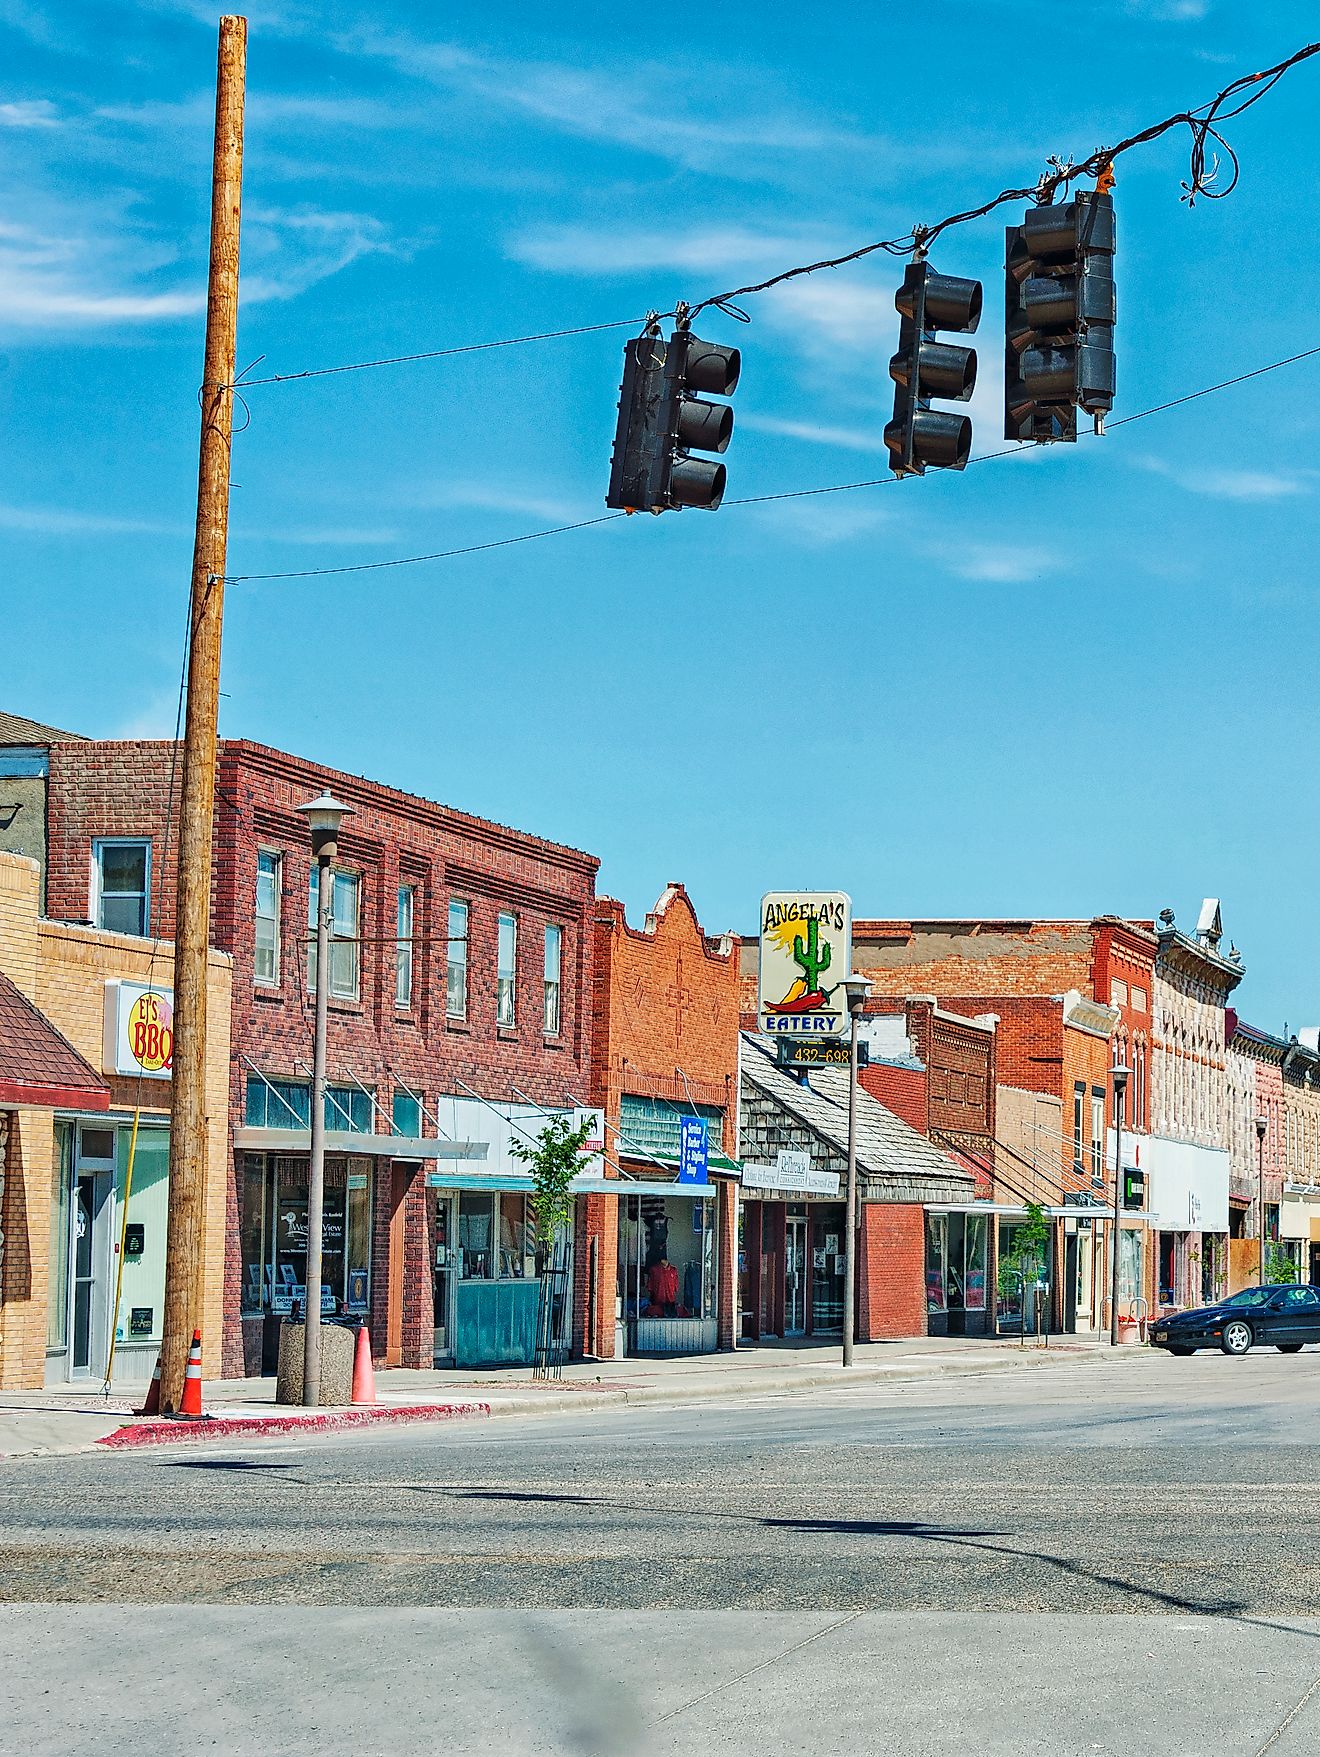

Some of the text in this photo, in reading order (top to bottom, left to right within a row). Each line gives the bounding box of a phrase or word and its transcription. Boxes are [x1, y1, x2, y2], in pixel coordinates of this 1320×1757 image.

[763, 902, 845, 934] ANGELA'S
[766, 1017, 837, 1031] EATERY
[134, 1022, 173, 1069] BBQ
[687, 1136, 701, 1148] Barber
[686, 1163, 697, 1178] Shop
[322, 1223, 342, 1232] View
